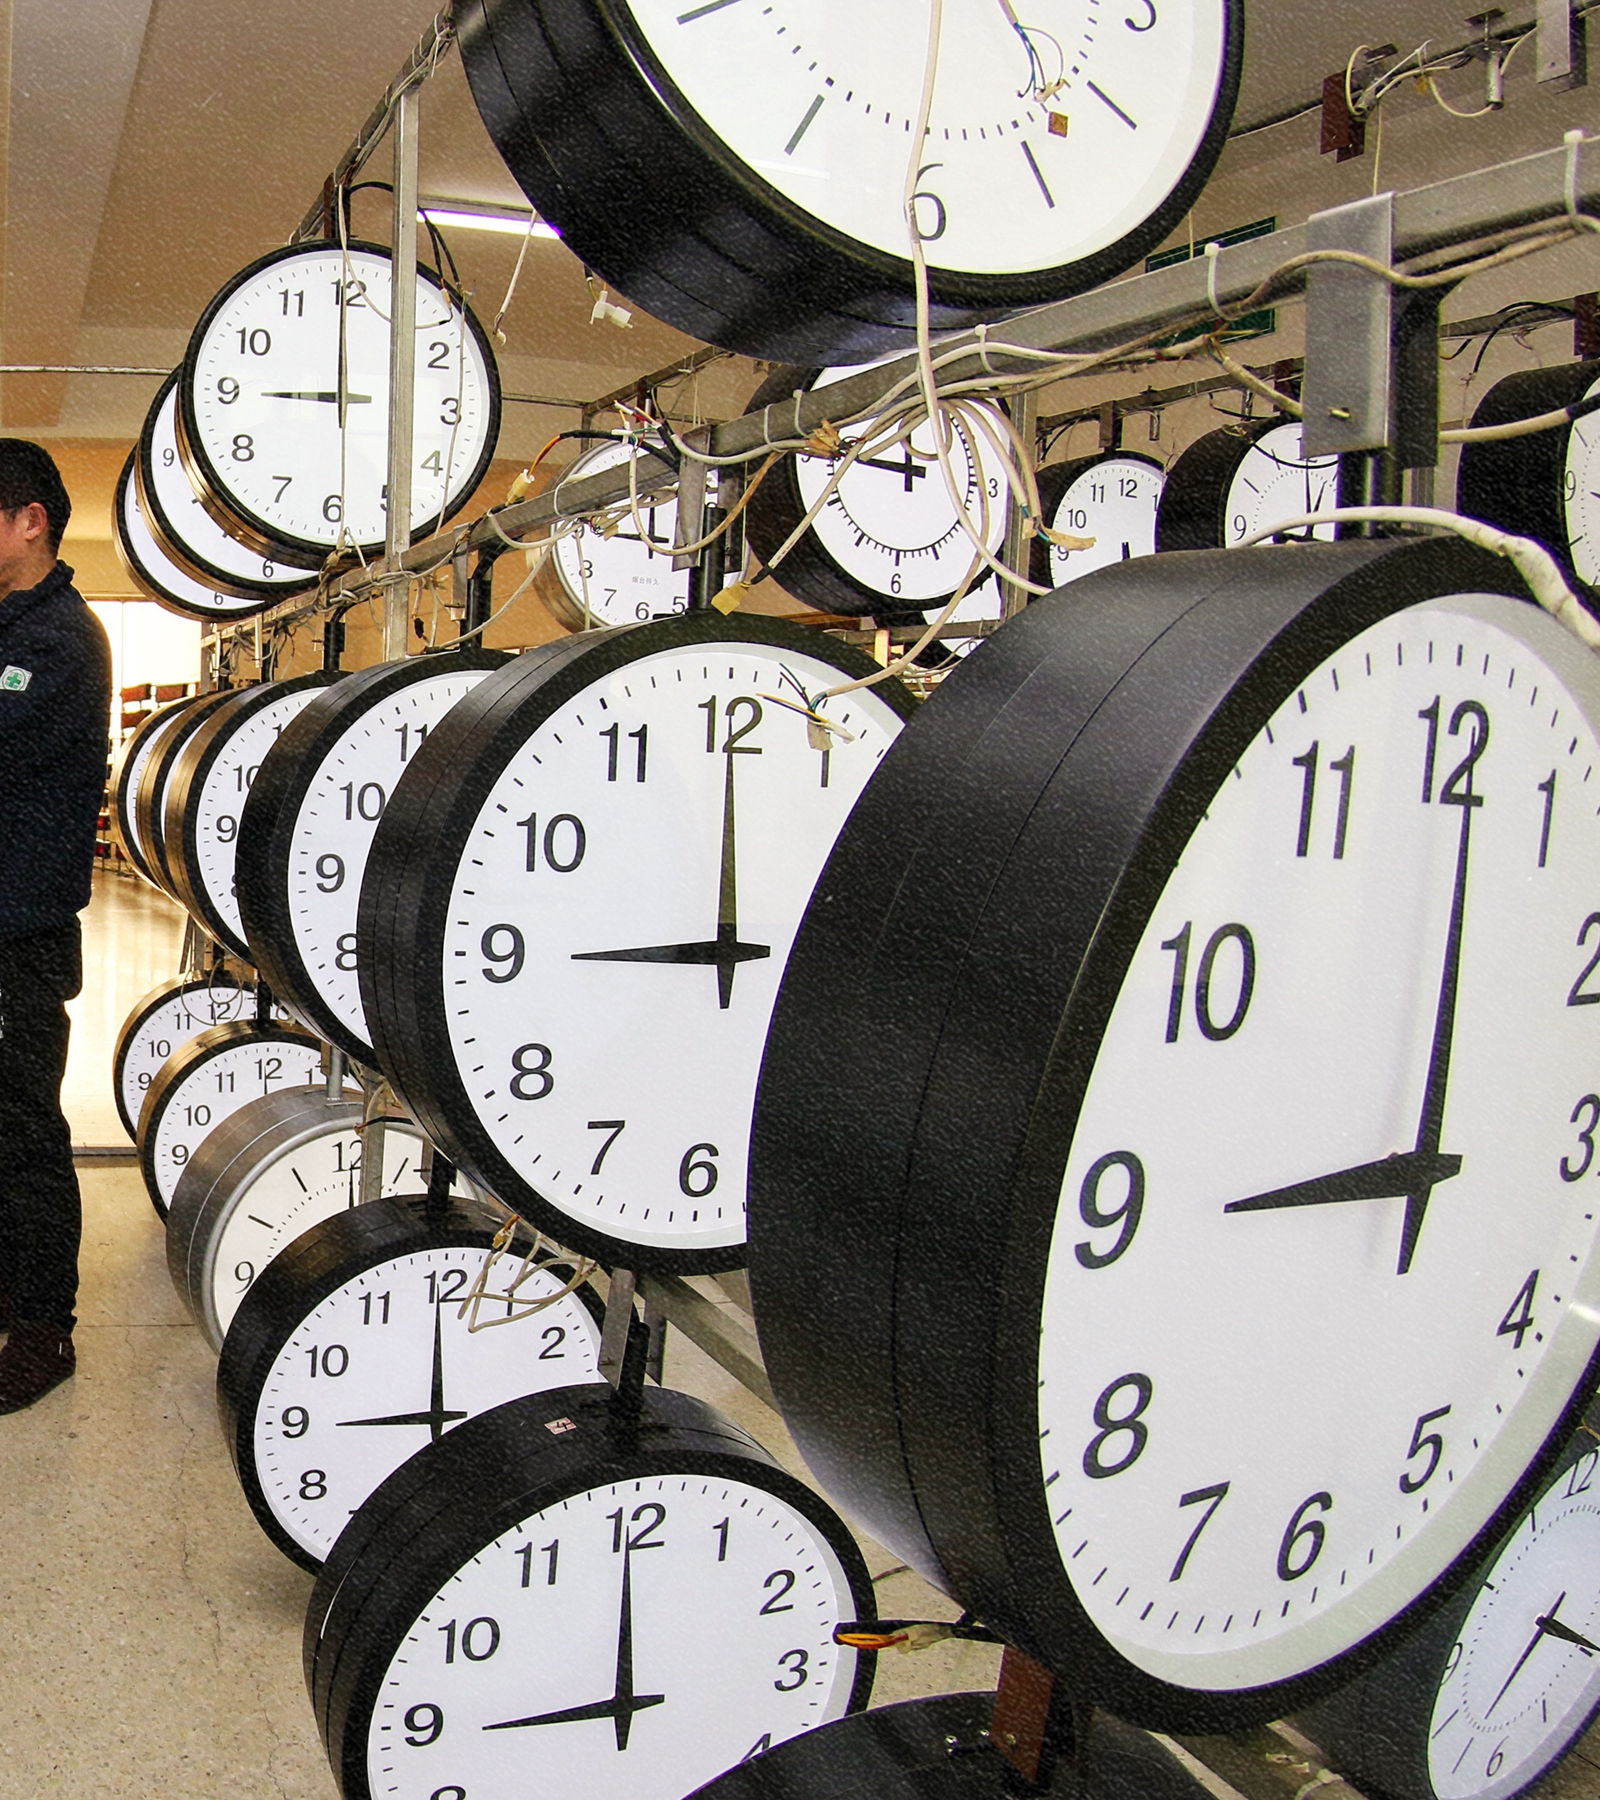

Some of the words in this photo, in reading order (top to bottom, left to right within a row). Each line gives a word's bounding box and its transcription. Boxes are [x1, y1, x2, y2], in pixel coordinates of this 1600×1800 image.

[905, 163, 946, 241] 6
[279, 289, 304, 317] 11
[331, 278, 367, 306] 12
[236, 327, 271, 356] 10
[427, 342, 450, 370] 2
[217, 377, 240, 405] 9
[439, 397, 462, 425] 3
[163, 448, 174, 467] 9
[232, 434, 254, 462] 8
[420, 451, 444, 476] 4
[272, 476, 292, 503] 7
[988, 478, 998, 498] 3
[1090, 483, 1104, 503] 11
[1118, 478, 1137, 498] 12
[322, 494, 343, 522] 6
[1067, 508, 1087, 529] 10
[1234, 515, 1247, 541] 9
[262, 560, 273, 577] 6
[579, 560, 593, 578] 8
[1056, 545, 1069, 561] 9
[604, 588, 617, 607] 7
[891, 573, 901, 594] 6
[635, 602, 650, 620] 6
[672, 596, 686, 614] 5
[698, 694, 763, 753] 12
[599, 722, 647, 783] 11
[1418, 695, 1490, 807] 12
[339, 781, 386, 821] 10
[1292, 740, 1355, 860] 11
[216, 815, 237, 843] 9
[1537, 768, 1557, 868] 1
[516, 812, 586, 873] 10
[316, 854, 345, 893] 9
[481, 923, 525, 983] 9
[1566, 911, 1600, 1007] 2
[1161, 921, 1256, 1044] 10
[174, 1013, 192, 1030] 11
[208, 1003, 231, 1020] 12
[148, 1040, 171, 1058] 10
[138, 1072, 152, 1090] 9
[215, 1071, 234, 1093] 11
[254, 1058, 283, 1083] 12
[305, 1068, 313, 1085] 1
[510, 1043, 554, 1101] 8
[184, 1105, 211, 1126] 10
[587, 1120, 625, 1175] 7
[1560, 1093, 1600, 1183] 3
[171, 1145, 189, 1165] 9
[679, 1143, 719, 1197] 6
[1074, 1150, 1145, 1270] 9
[234, 1261, 255, 1294] 9
[423, 1270, 468, 1303] 12
[358, 1291, 390, 1325] 11
[1496, 1269, 1540, 1349] 4
[538, 1327, 565, 1360] 2
[305, 1344, 349, 1378] 10
[282, 1406, 309, 1439] 9
[1082, 1372, 1153, 1479] 8
[1399, 1404, 1452, 1494] 5
[299, 1469, 327, 1500] 8
[1561, 1449, 1600, 1499] 12
[605, 1502, 666, 1553] 12
[713, 1517, 729, 1562] 1
[1169, 1481, 1231, 1583] 7
[1277, 1491, 1332, 1581] 6
[514, 1539, 559, 1588] 11
[759, 1569, 795, 1616] 2
[438, 1617, 500, 1664] 10
[774, 1649, 808, 1692] 3
[1440, 1642, 1463, 1686] 9
[404, 1703, 443, 1747] 9
[1486, 1736, 1509, 1777] 6
